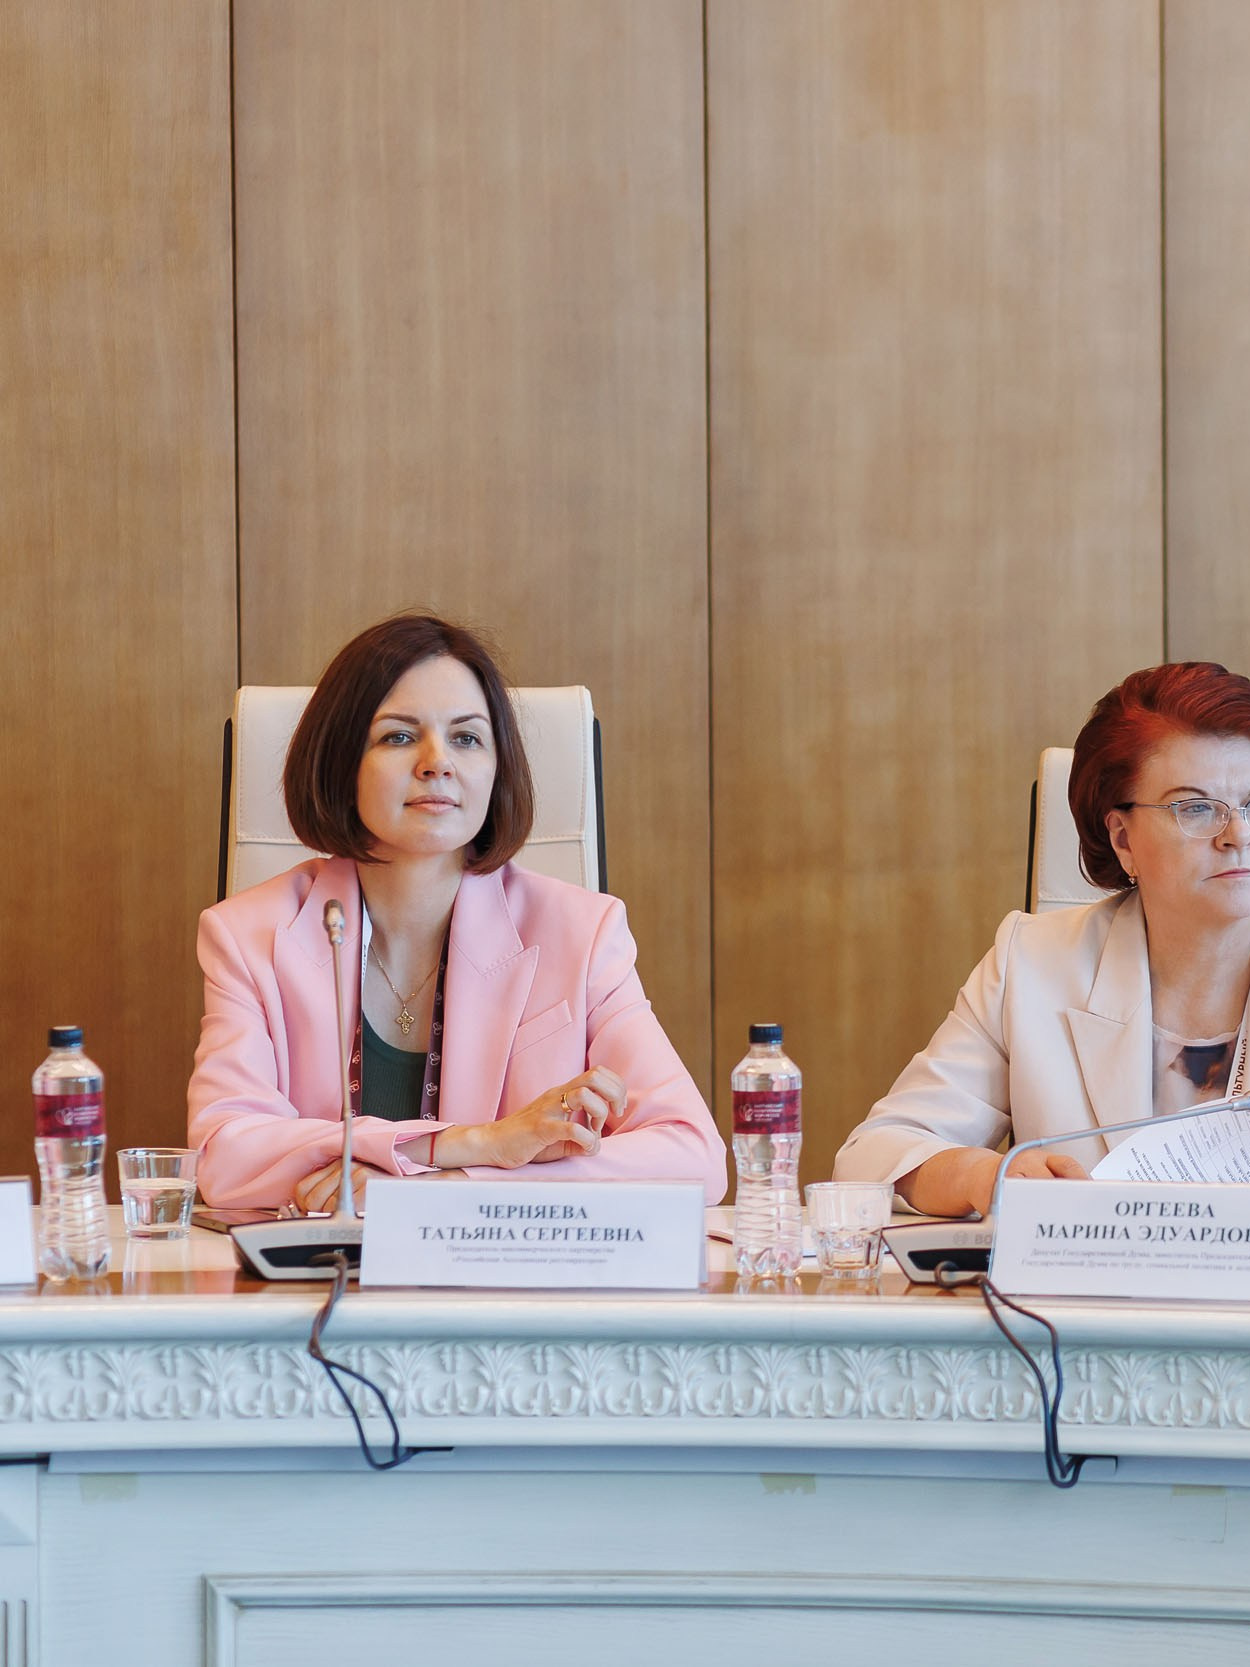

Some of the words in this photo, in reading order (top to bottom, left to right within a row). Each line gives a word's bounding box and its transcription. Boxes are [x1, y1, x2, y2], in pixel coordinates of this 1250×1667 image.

[478, 1203, 588, 1220] ЧЕРНЯЕВА
[1114, 1200, 1215, 1218] ОРГЕЕВА
[418, 1225, 516, 1241] ТАТЬЯНА
[522, 1226, 645, 1242] СЕРГЕЕВНА
[1035, 1223, 1131, 1240] МАРИНА
